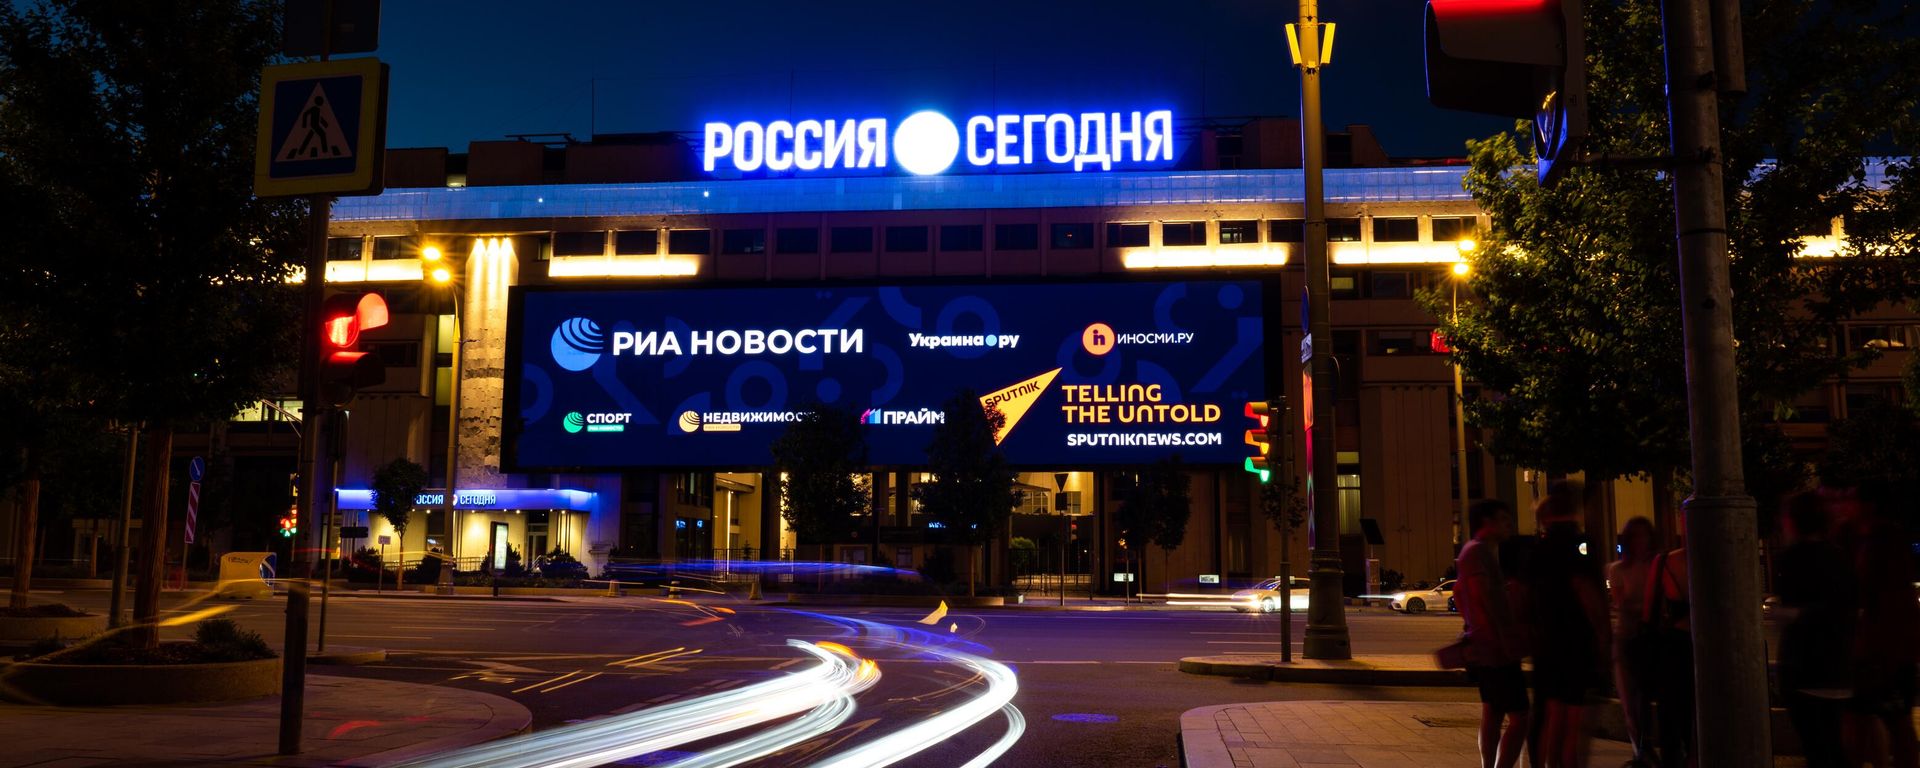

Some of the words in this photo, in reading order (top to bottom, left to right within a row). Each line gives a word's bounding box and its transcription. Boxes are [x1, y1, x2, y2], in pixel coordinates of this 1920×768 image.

[704, 118, 887, 171] РОССИЯ
[966, 110, 1174, 172] СЕГОДНЯ
[613, 331, 683, 356] РИА
[690, 328, 863, 355] НОВОСТИ
[1117, 332, 1194, 344] ИНОСМИ.РУ
[985, 380, 1040, 407] SPUTNIK
[1061, 383, 1162, 403] TELLING
[586, 412, 632, 424] СПОРТ
[702, 411, 819, 425] НЕДВИЖИМОС
[883, 407, 945, 425] ПРАЙМ
[1061, 405, 1111, 424] THE
[1118, 403, 1221, 423] UNTOLD
[1067, 432, 1222, 447] SPUTNIKNEWS.COM
[414, 494, 444, 505] ОССИЯ
[459, 494, 496, 506] СЕГОДНЯ
